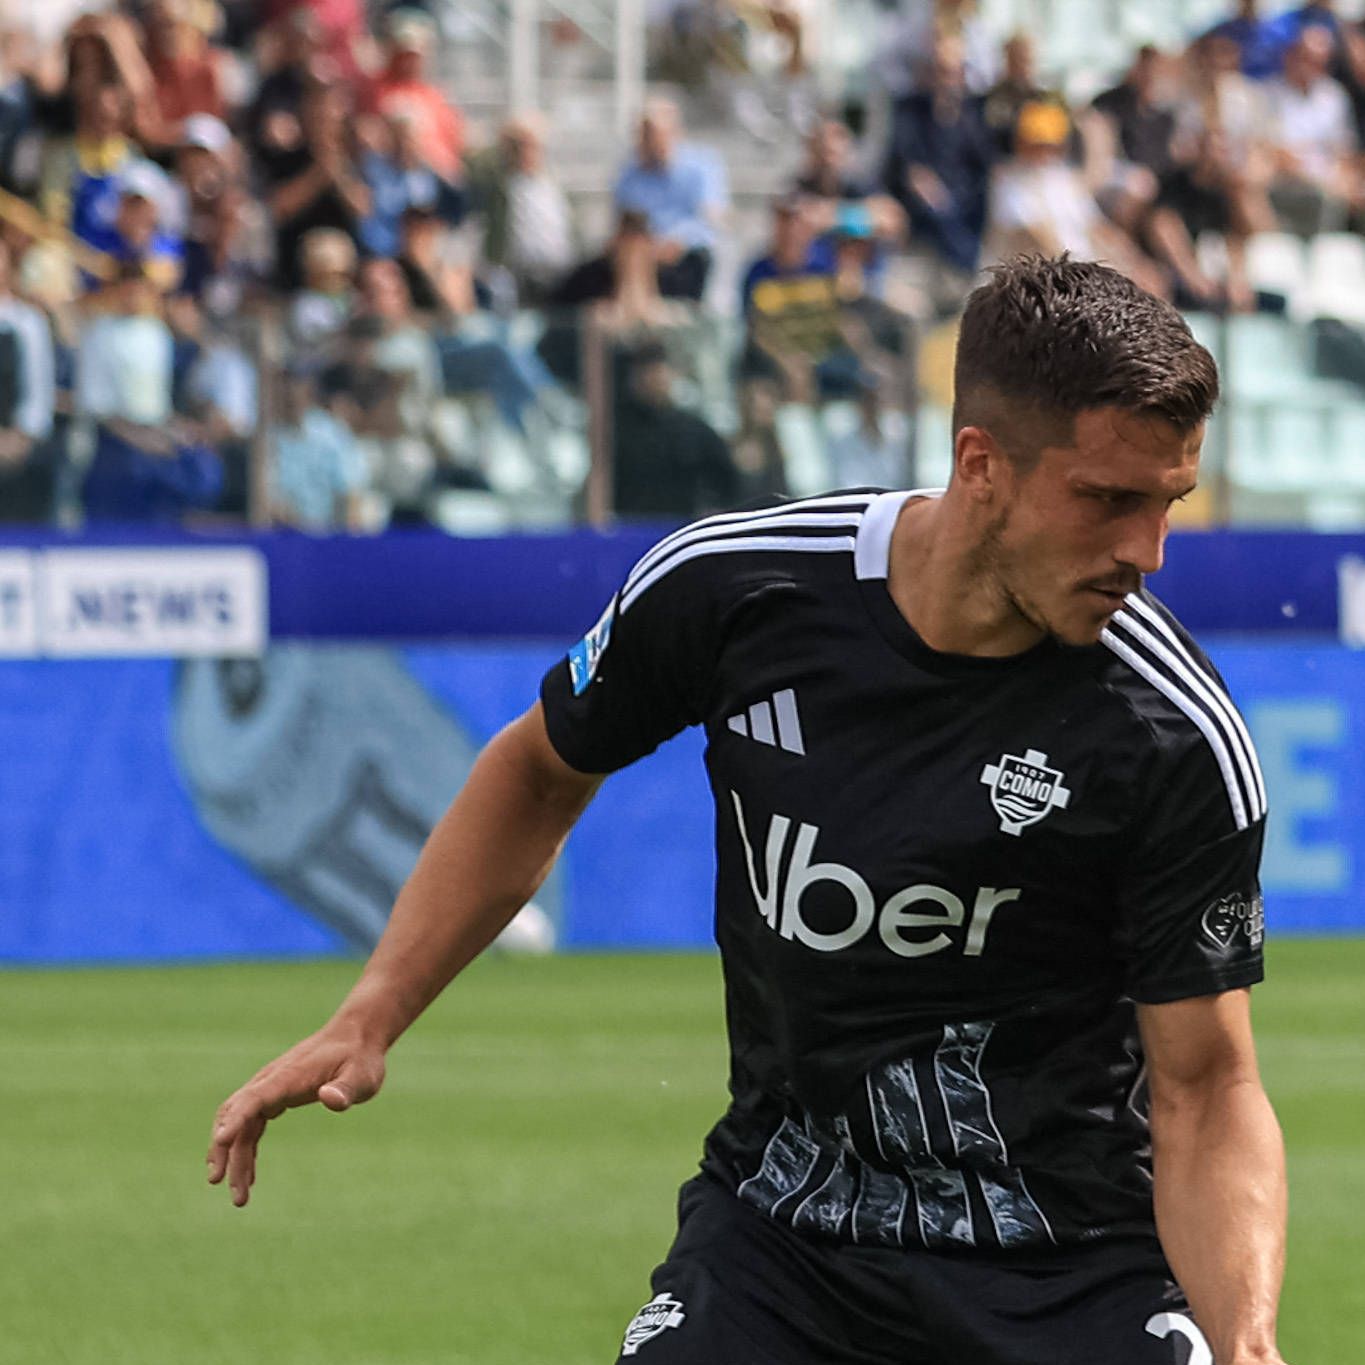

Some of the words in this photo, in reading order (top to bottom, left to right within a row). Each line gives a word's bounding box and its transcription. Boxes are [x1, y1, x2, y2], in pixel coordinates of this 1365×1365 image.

[72, 580, 233, 630] NEWS
[998, 769, 1052, 803] COMO
[731, 789, 1022, 958] Uber
